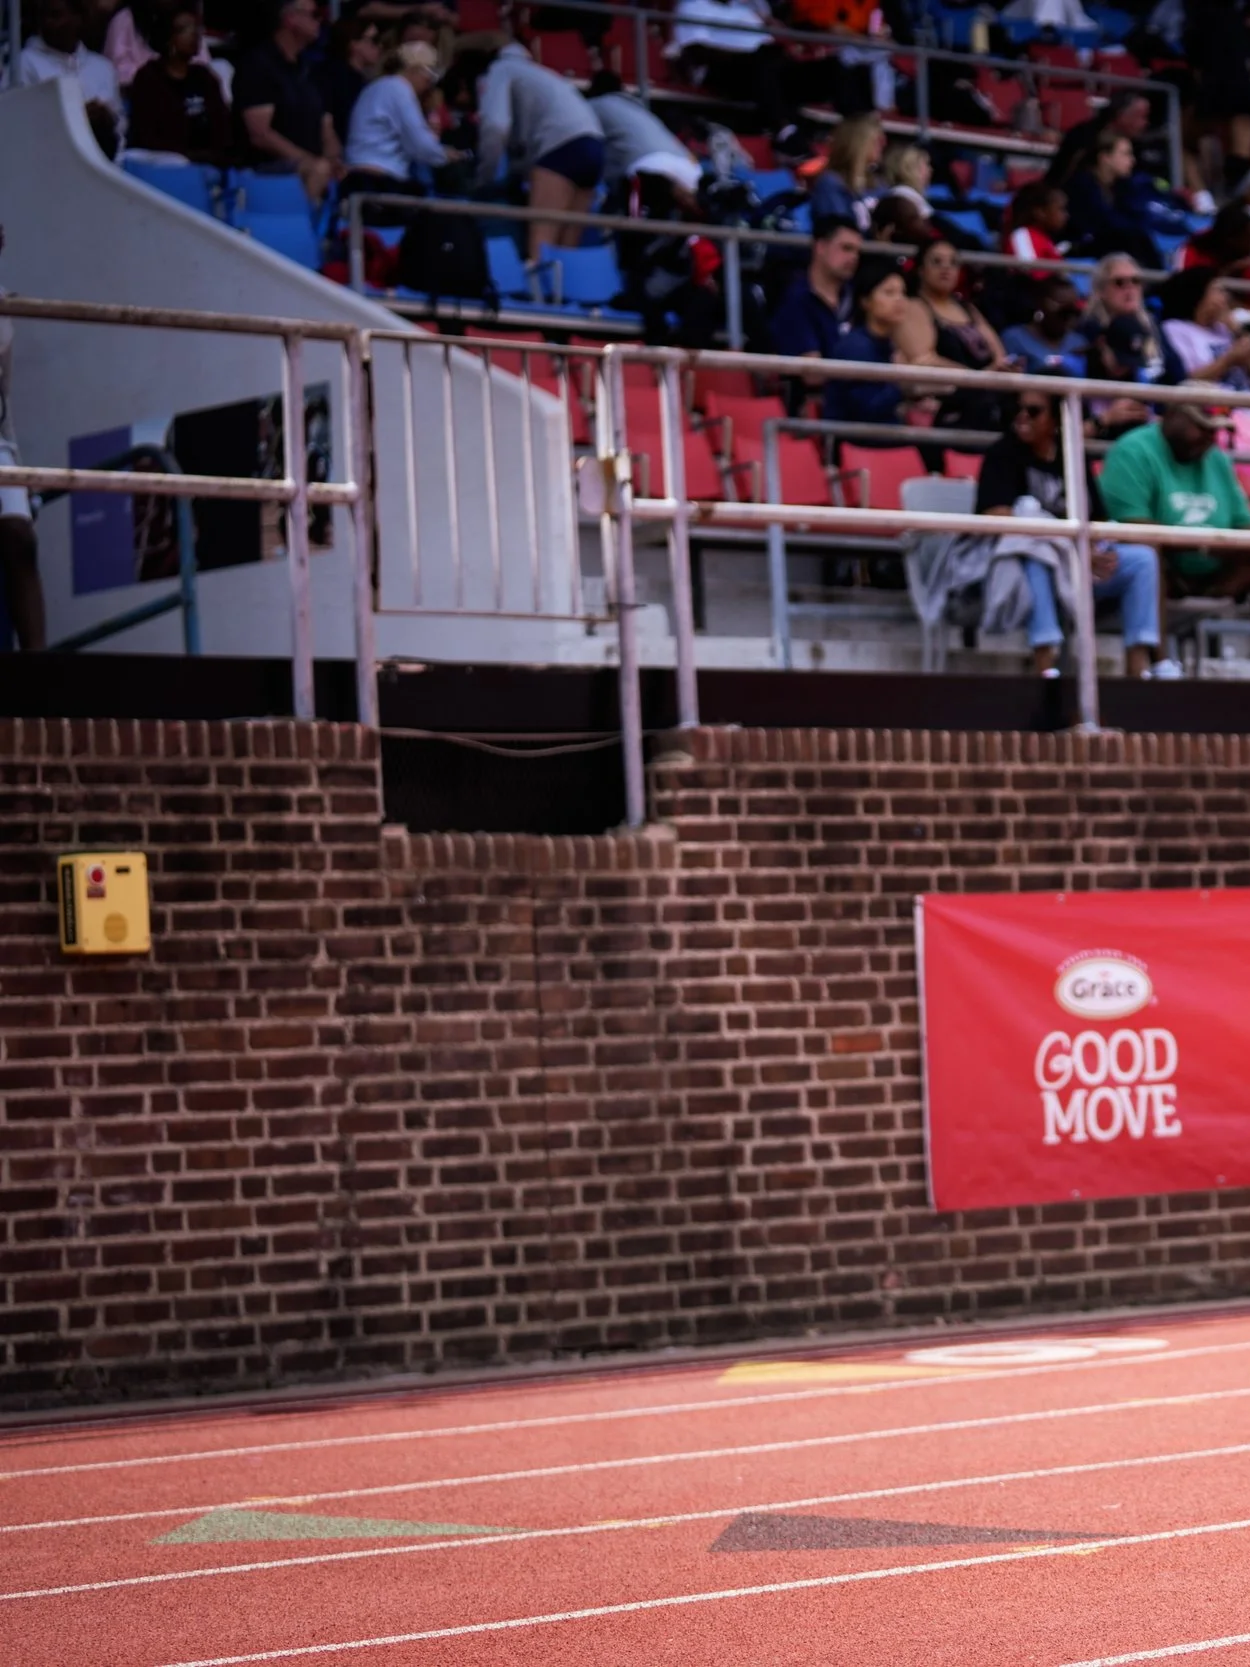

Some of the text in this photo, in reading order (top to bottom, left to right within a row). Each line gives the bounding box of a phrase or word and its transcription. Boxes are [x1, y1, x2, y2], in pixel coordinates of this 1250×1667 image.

[1070, 977, 1138, 1000] Grace
[1034, 1028, 1179, 1091] GOOD
[1040, 1083, 1183, 1146] MOVE
